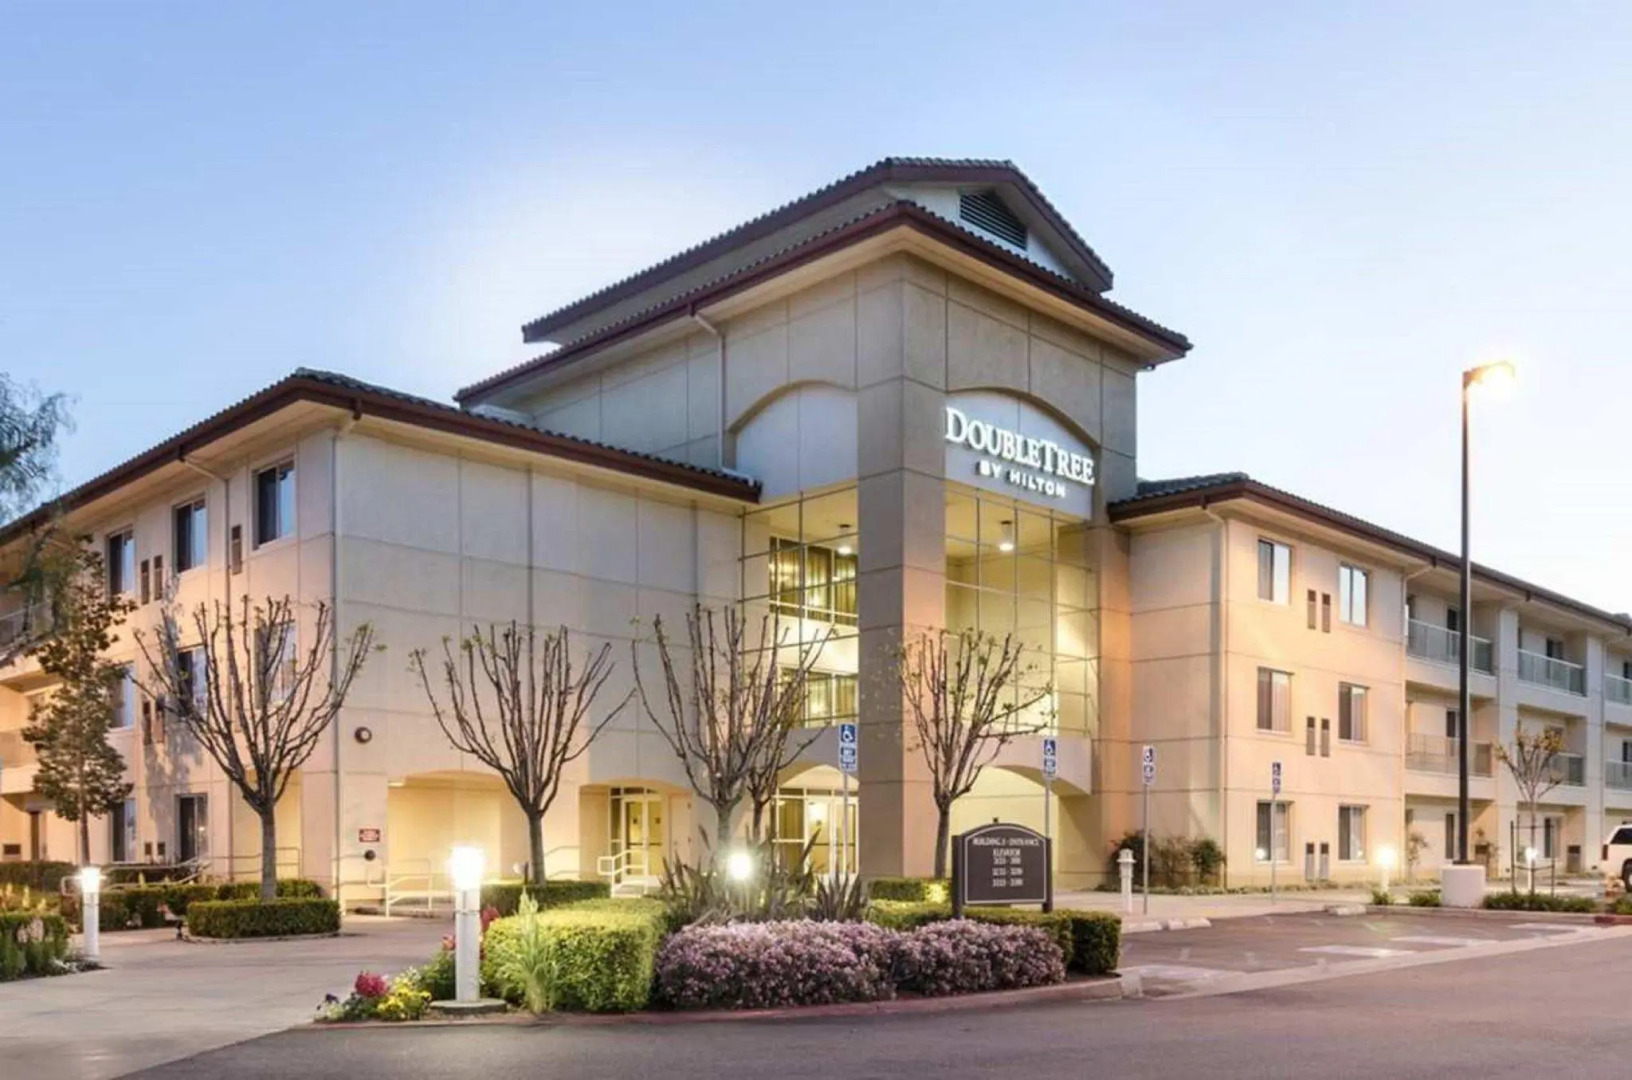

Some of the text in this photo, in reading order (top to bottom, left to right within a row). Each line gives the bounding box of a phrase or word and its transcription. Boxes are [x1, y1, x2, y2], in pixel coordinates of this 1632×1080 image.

[945, 407, 1095, 485] DOUBLETREE
[979, 459, 1066, 498] BY HILTON
